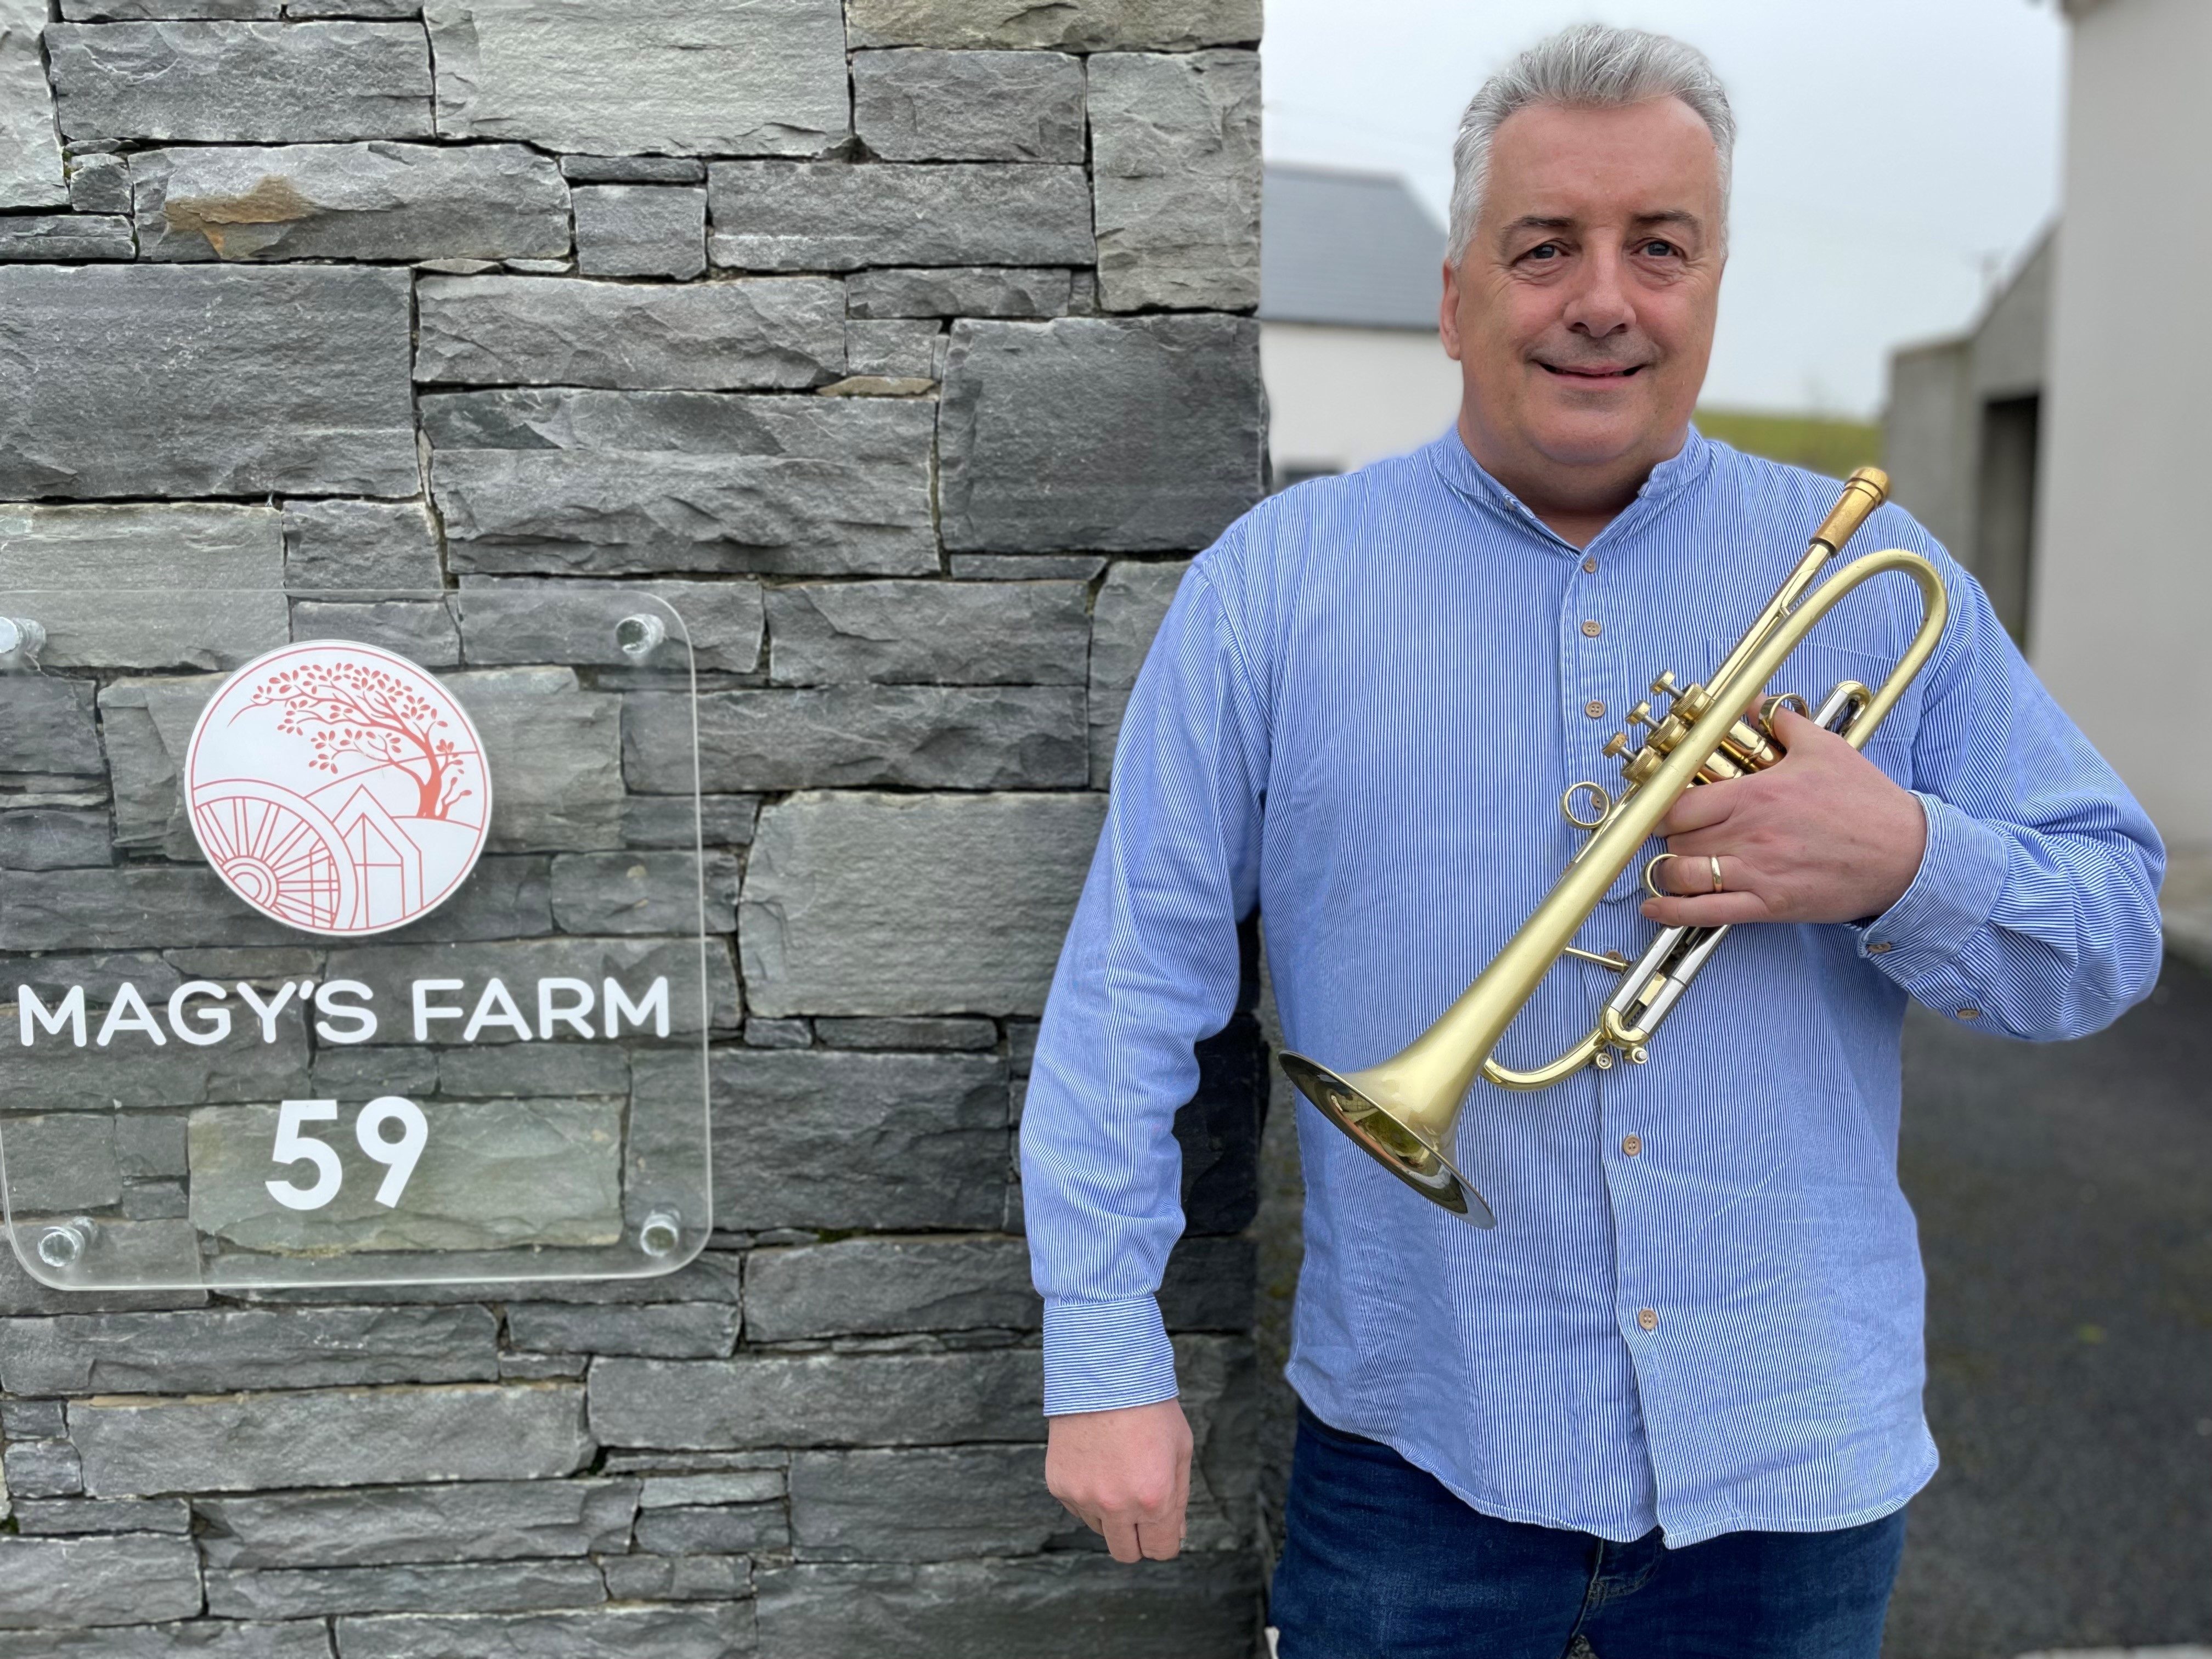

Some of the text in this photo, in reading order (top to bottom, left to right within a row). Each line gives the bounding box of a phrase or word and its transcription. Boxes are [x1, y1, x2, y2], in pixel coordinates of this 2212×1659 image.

[18, 976, 670, 1047] MAGY'S FARM
[264, 1096, 429, 1210] 59
